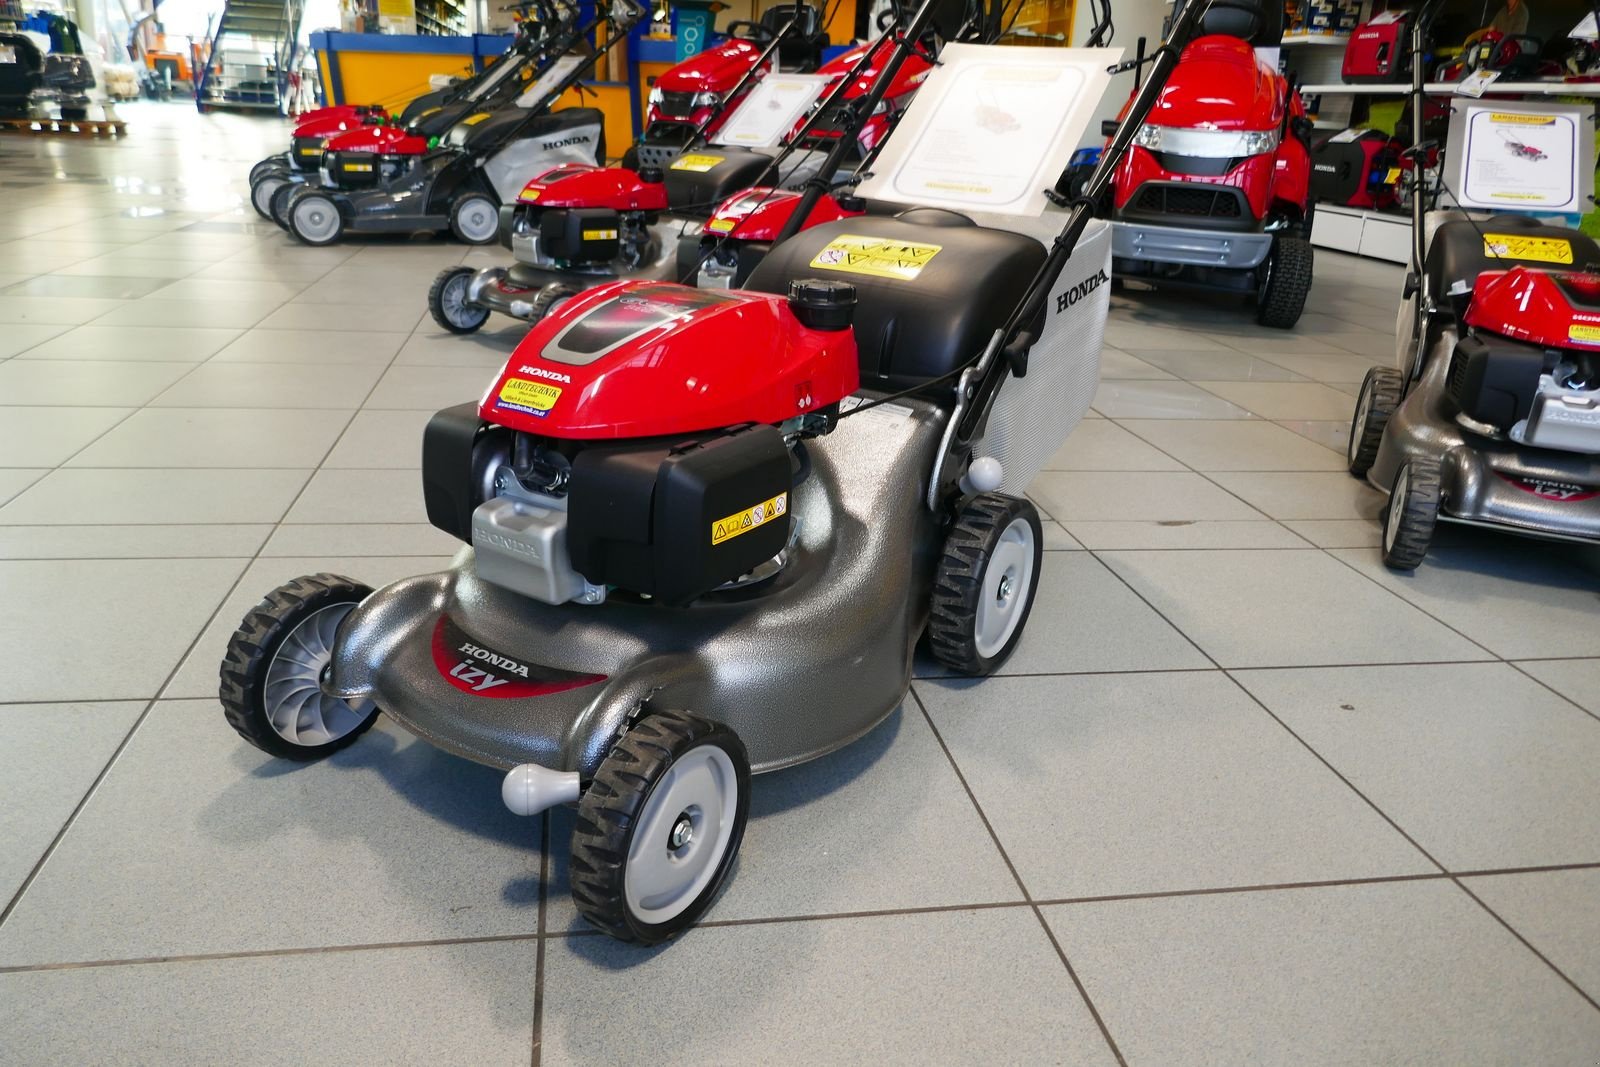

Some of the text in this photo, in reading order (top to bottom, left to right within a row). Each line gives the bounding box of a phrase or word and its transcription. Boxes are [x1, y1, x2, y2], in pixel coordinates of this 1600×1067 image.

[542, 135, 591, 151] HONDA
[1056, 268, 1110, 315] HONDA
[518, 365, 571, 383] HONDA
[507, 380, 559, 398] LANDTECHNIK
[1522, 477, 1584, 492] HONDA
[458, 642, 530, 678] HONDA
[449, 659, 510, 691] izy
